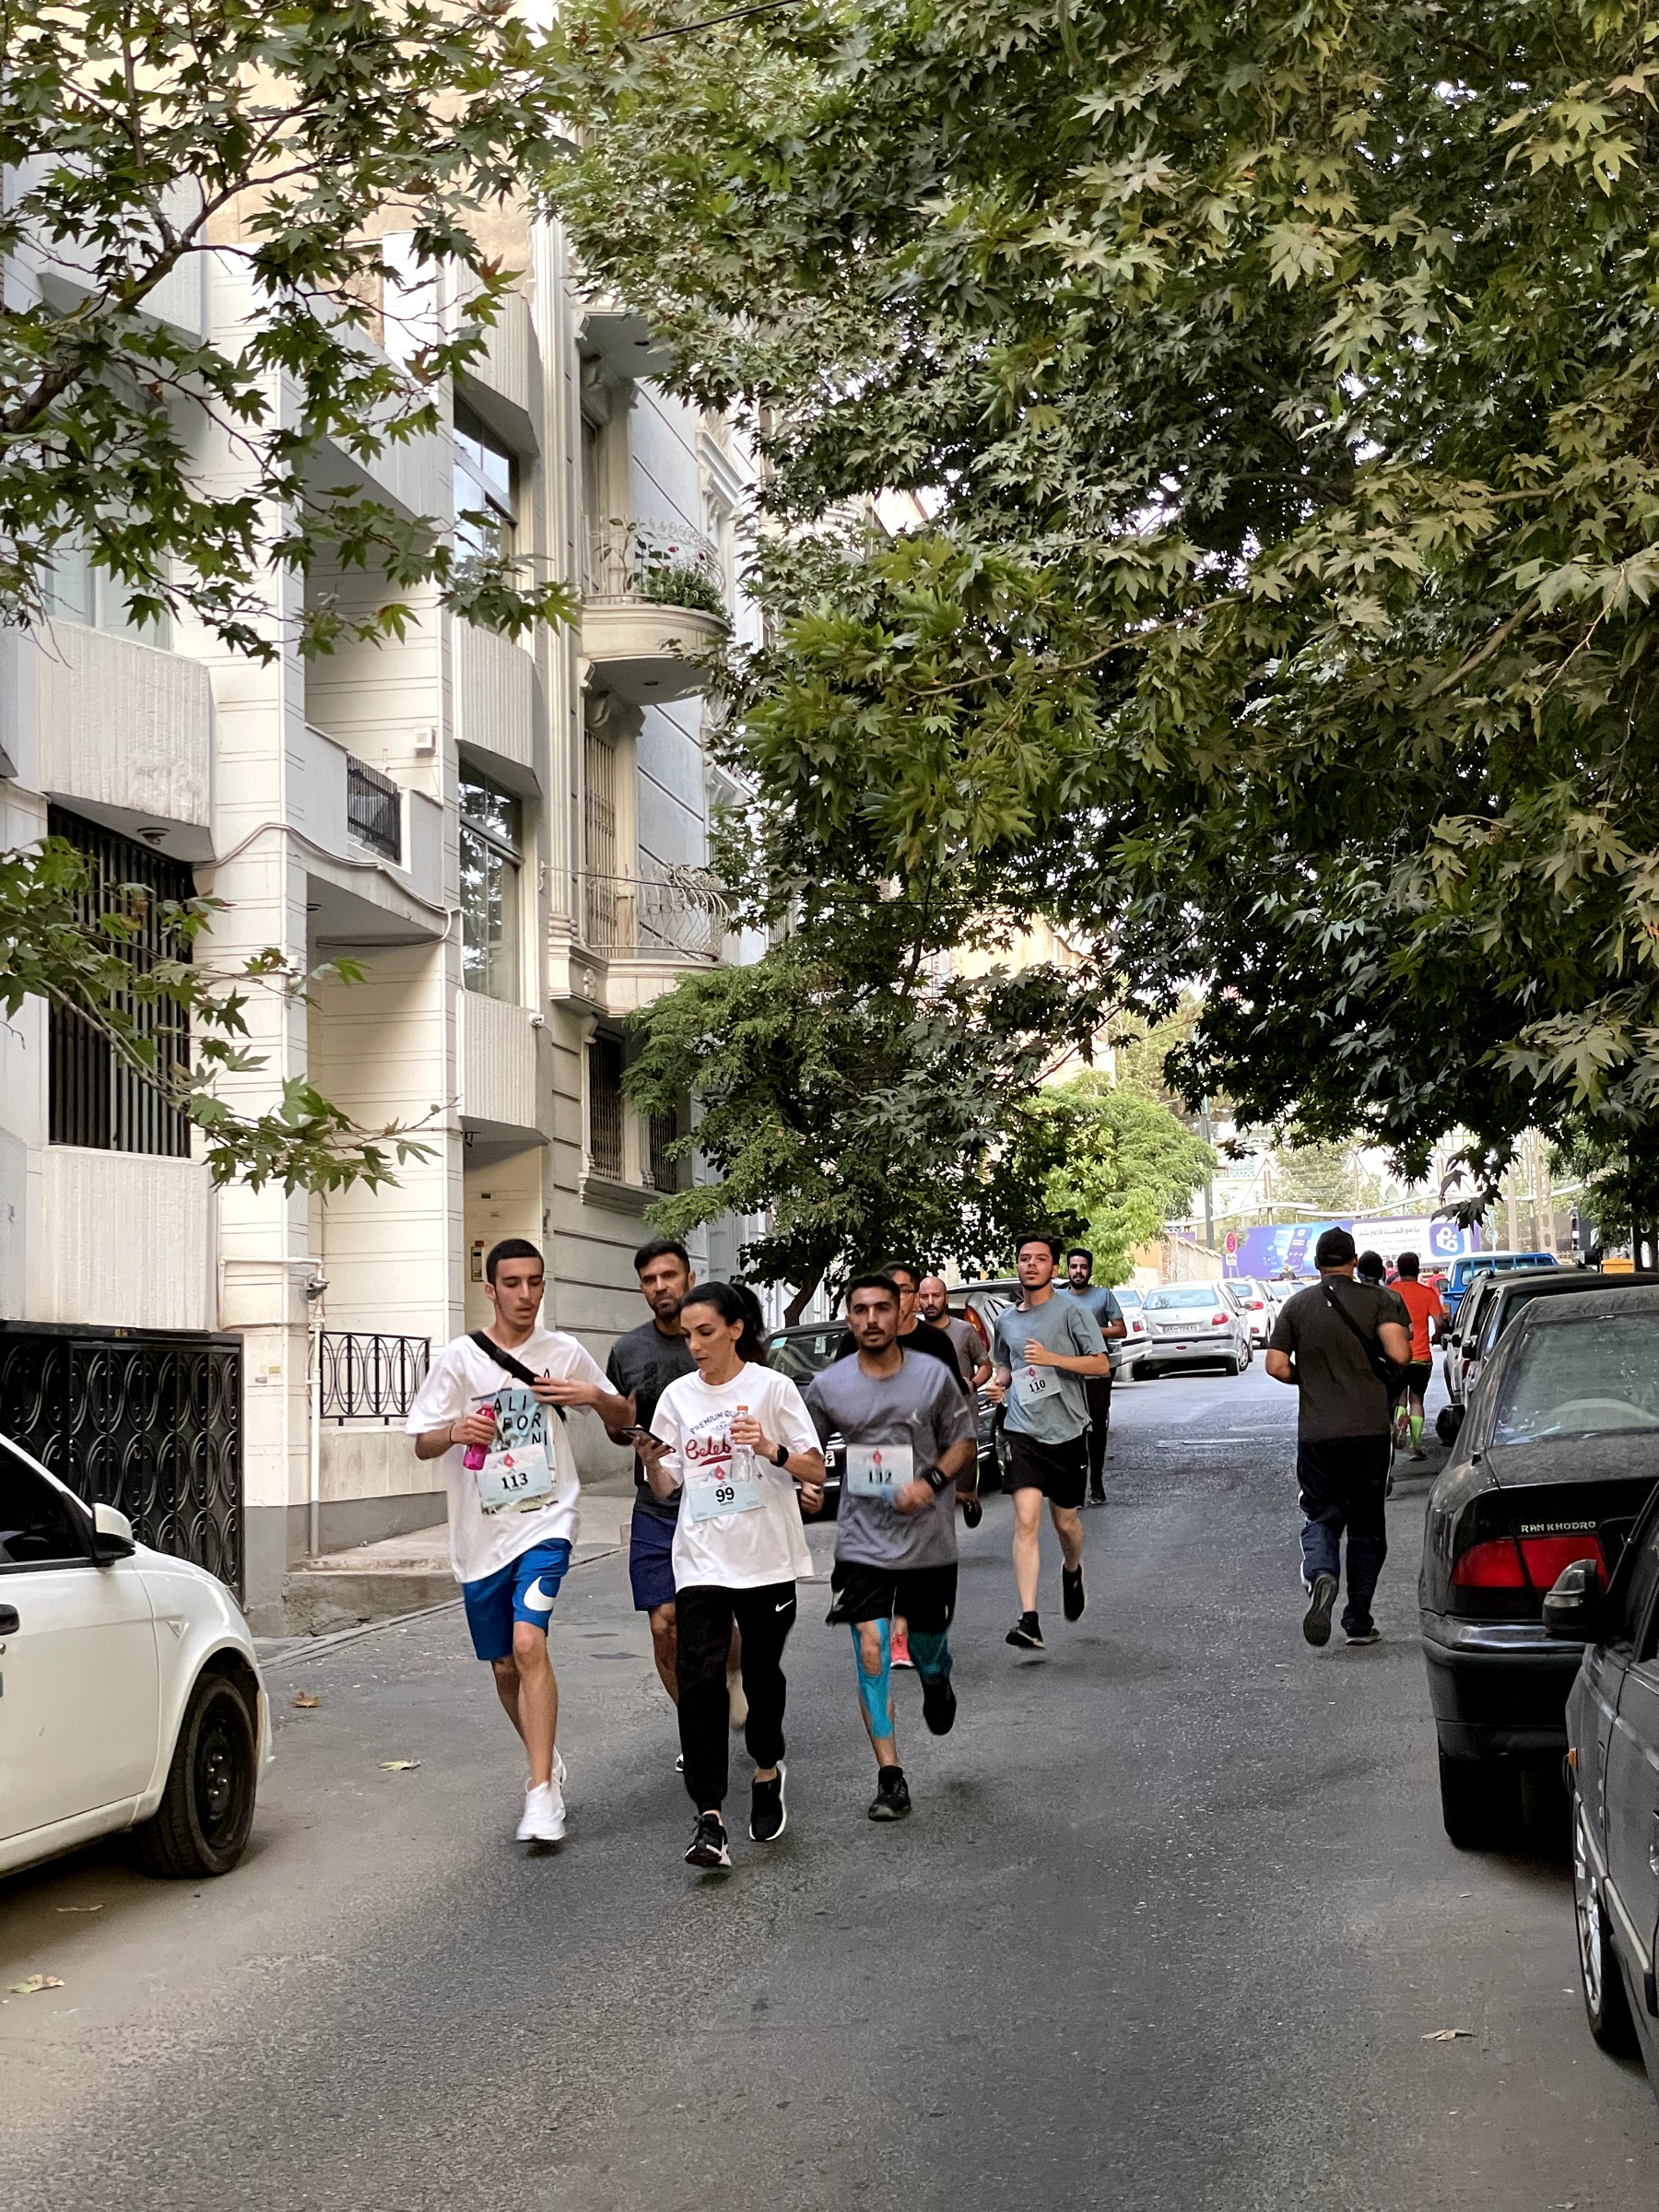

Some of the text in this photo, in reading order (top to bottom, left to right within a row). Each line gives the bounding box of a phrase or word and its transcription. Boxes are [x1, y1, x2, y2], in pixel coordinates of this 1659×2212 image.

[1029, 1379, 1046, 1393] 110
[689, 1410, 724, 1435] PREMIUM
[686, 1433, 732, 1460] Celeb
[501, 1472, 528, 1489] 113
[715, 1487, 735, 1502] 99
